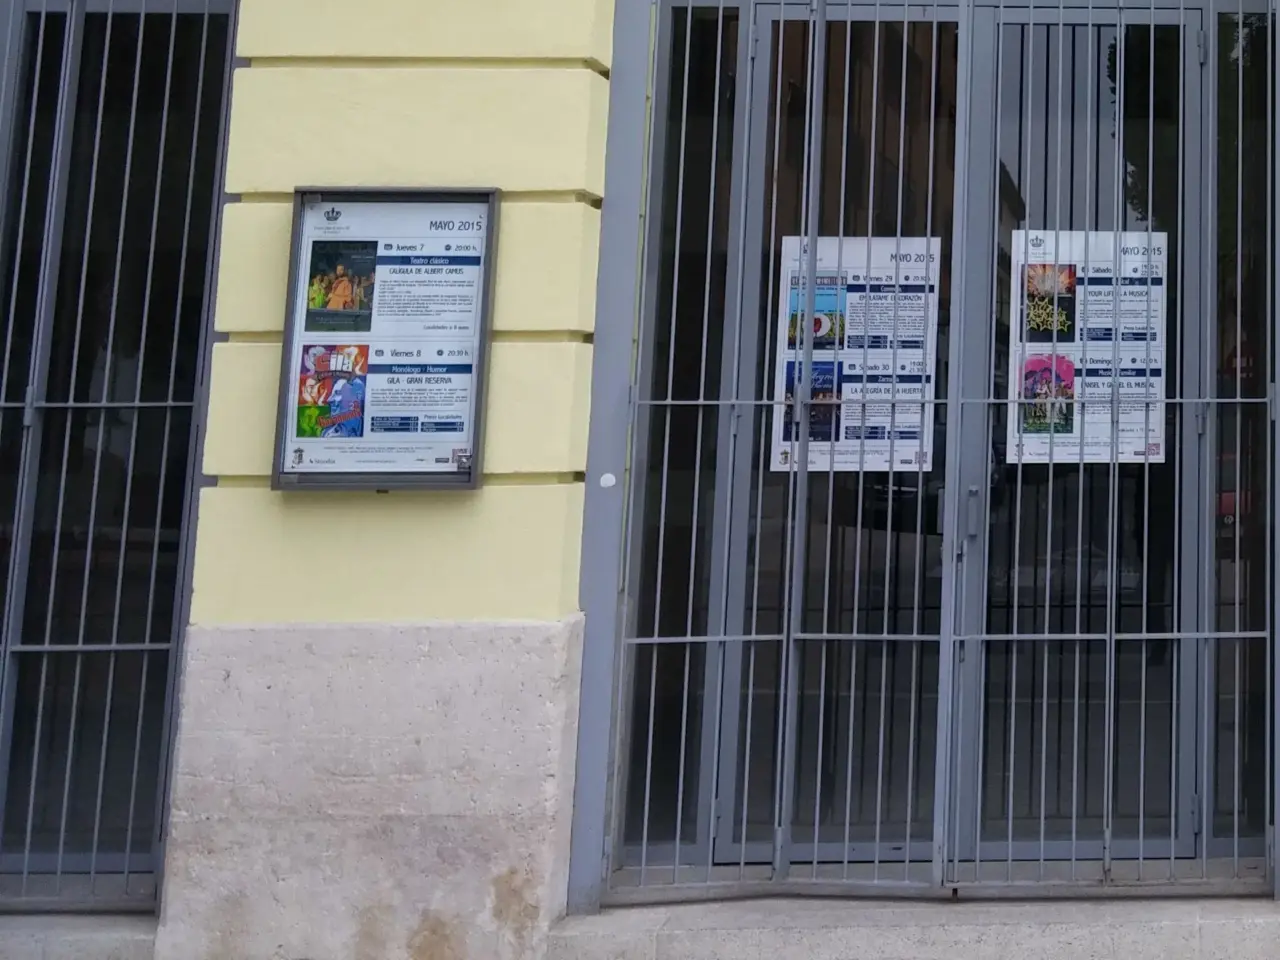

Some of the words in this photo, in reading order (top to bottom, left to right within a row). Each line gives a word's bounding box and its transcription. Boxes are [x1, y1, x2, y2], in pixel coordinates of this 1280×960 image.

[429, 221, 455, 231] MAYO
[458, 221, 482, 231] 2015
[410, 257, 428, 265] Teatro
[429, 257, 449, 265] clásico
[914, 254, 935, 262] 205
[390, 349, 414, 357] Viernes
[426, 365, 448, 373] Humor
